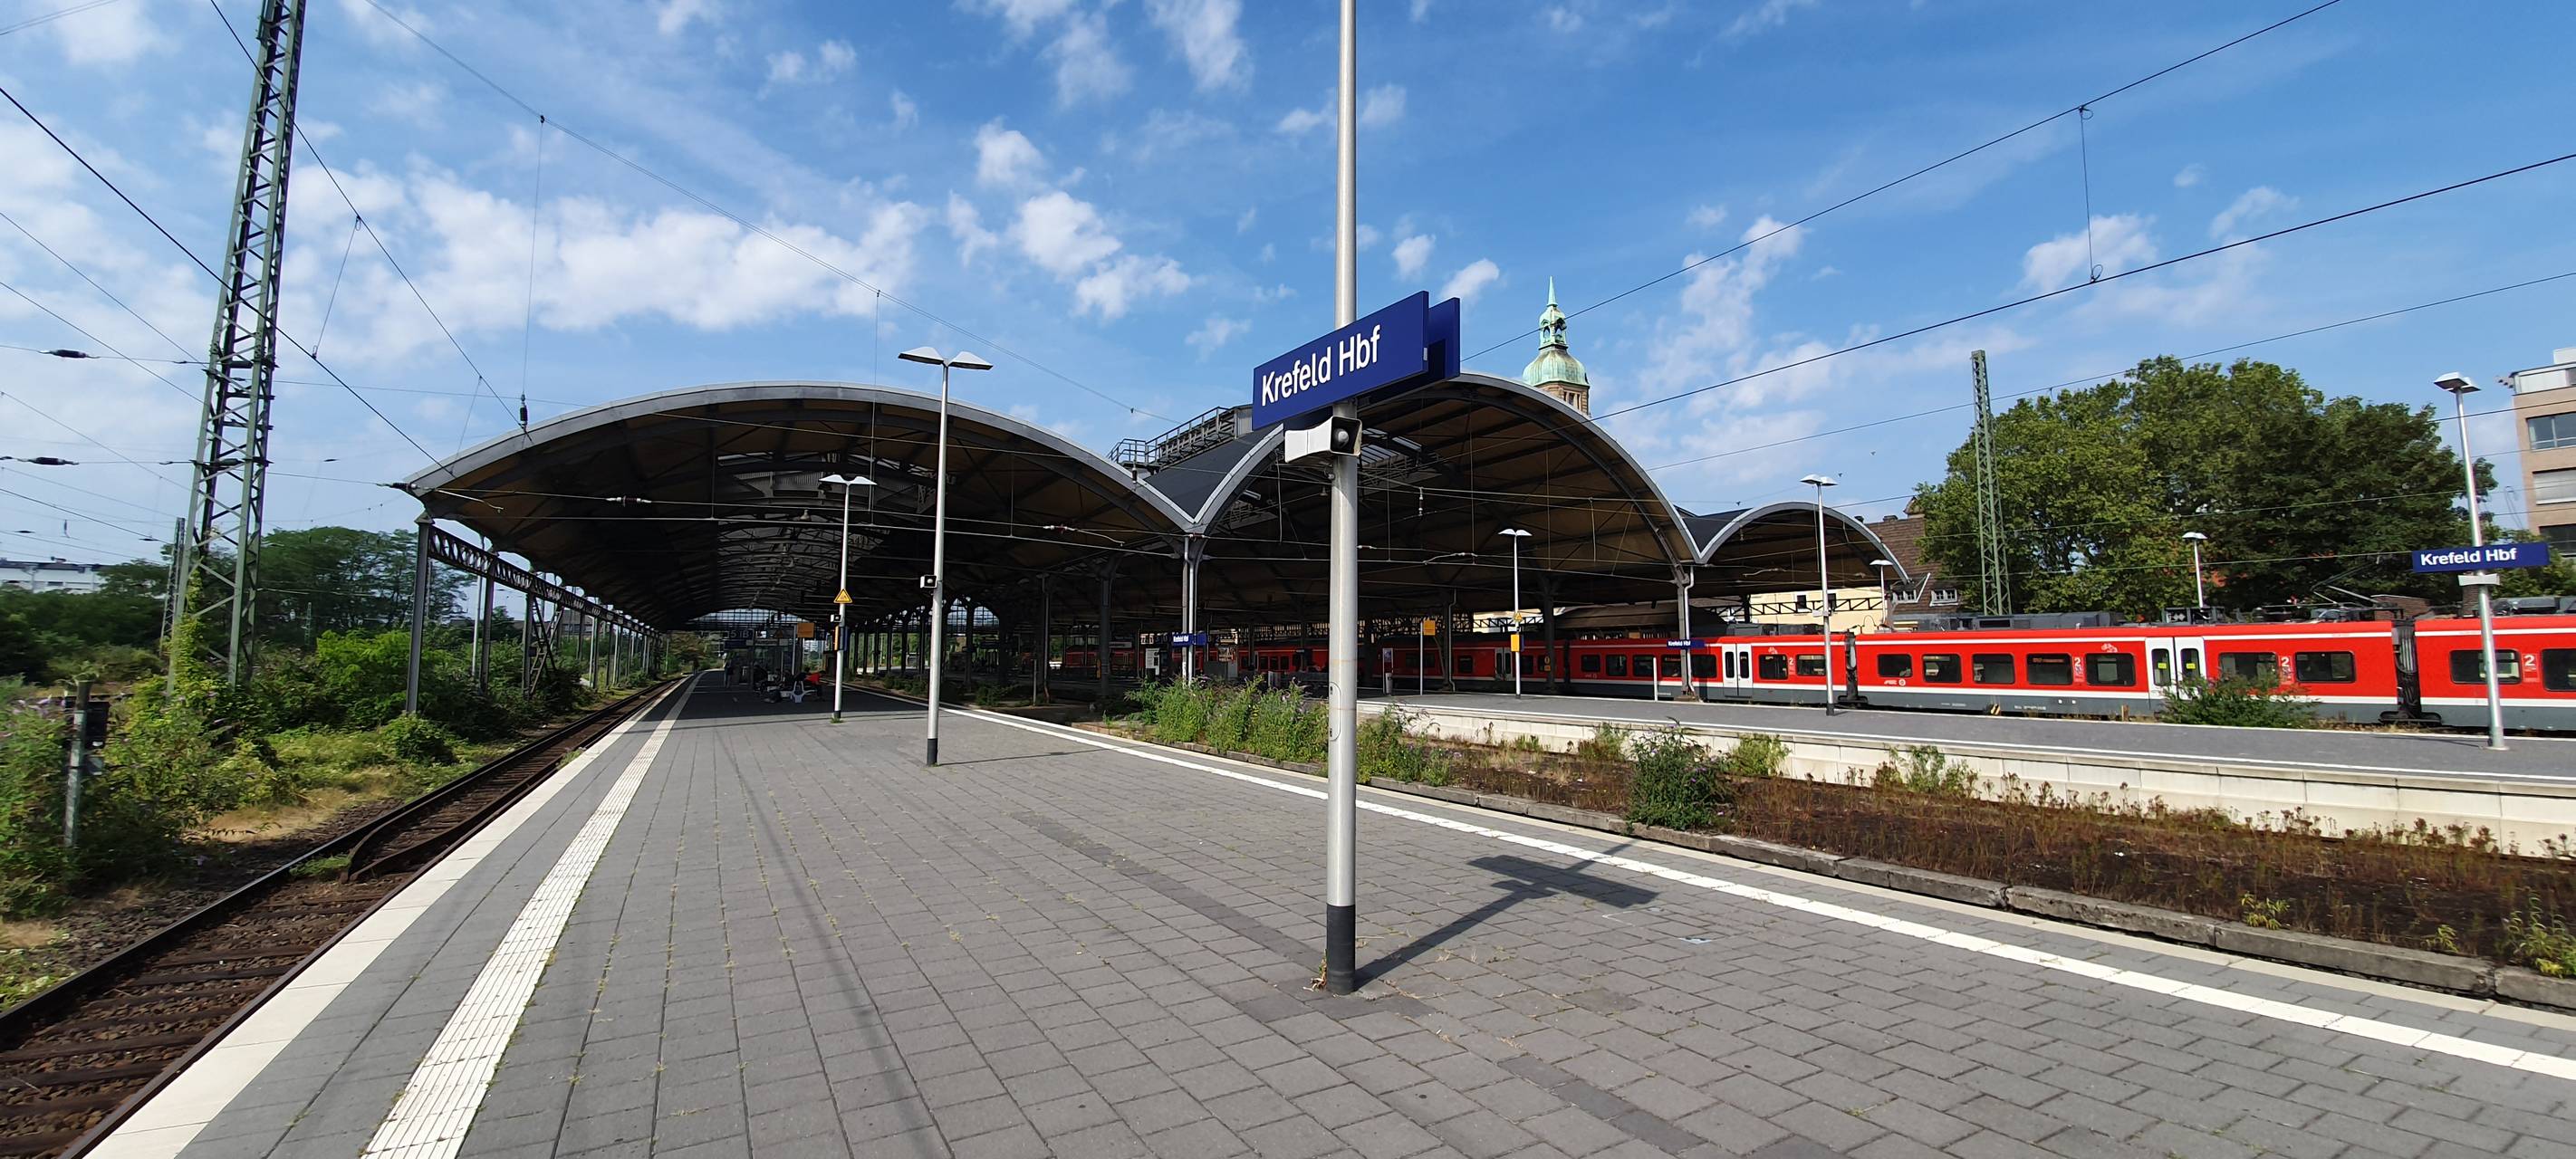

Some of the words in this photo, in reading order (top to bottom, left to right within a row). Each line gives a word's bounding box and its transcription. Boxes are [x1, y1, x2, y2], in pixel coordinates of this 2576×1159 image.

[1262, 346, 1331, 407] Krefeld
[1339, 324, 1381, 377] Hbf
[2420, 550, 2480, 566] Krefeld
[2485, 548, 2517, 562] Hbf
[1788, 657, 1794, 666] 2
[2074, 657, 2081, 666] 2
[2281, 656, 2290, 667] 2
[2524, 655, 2536, 666] 2
